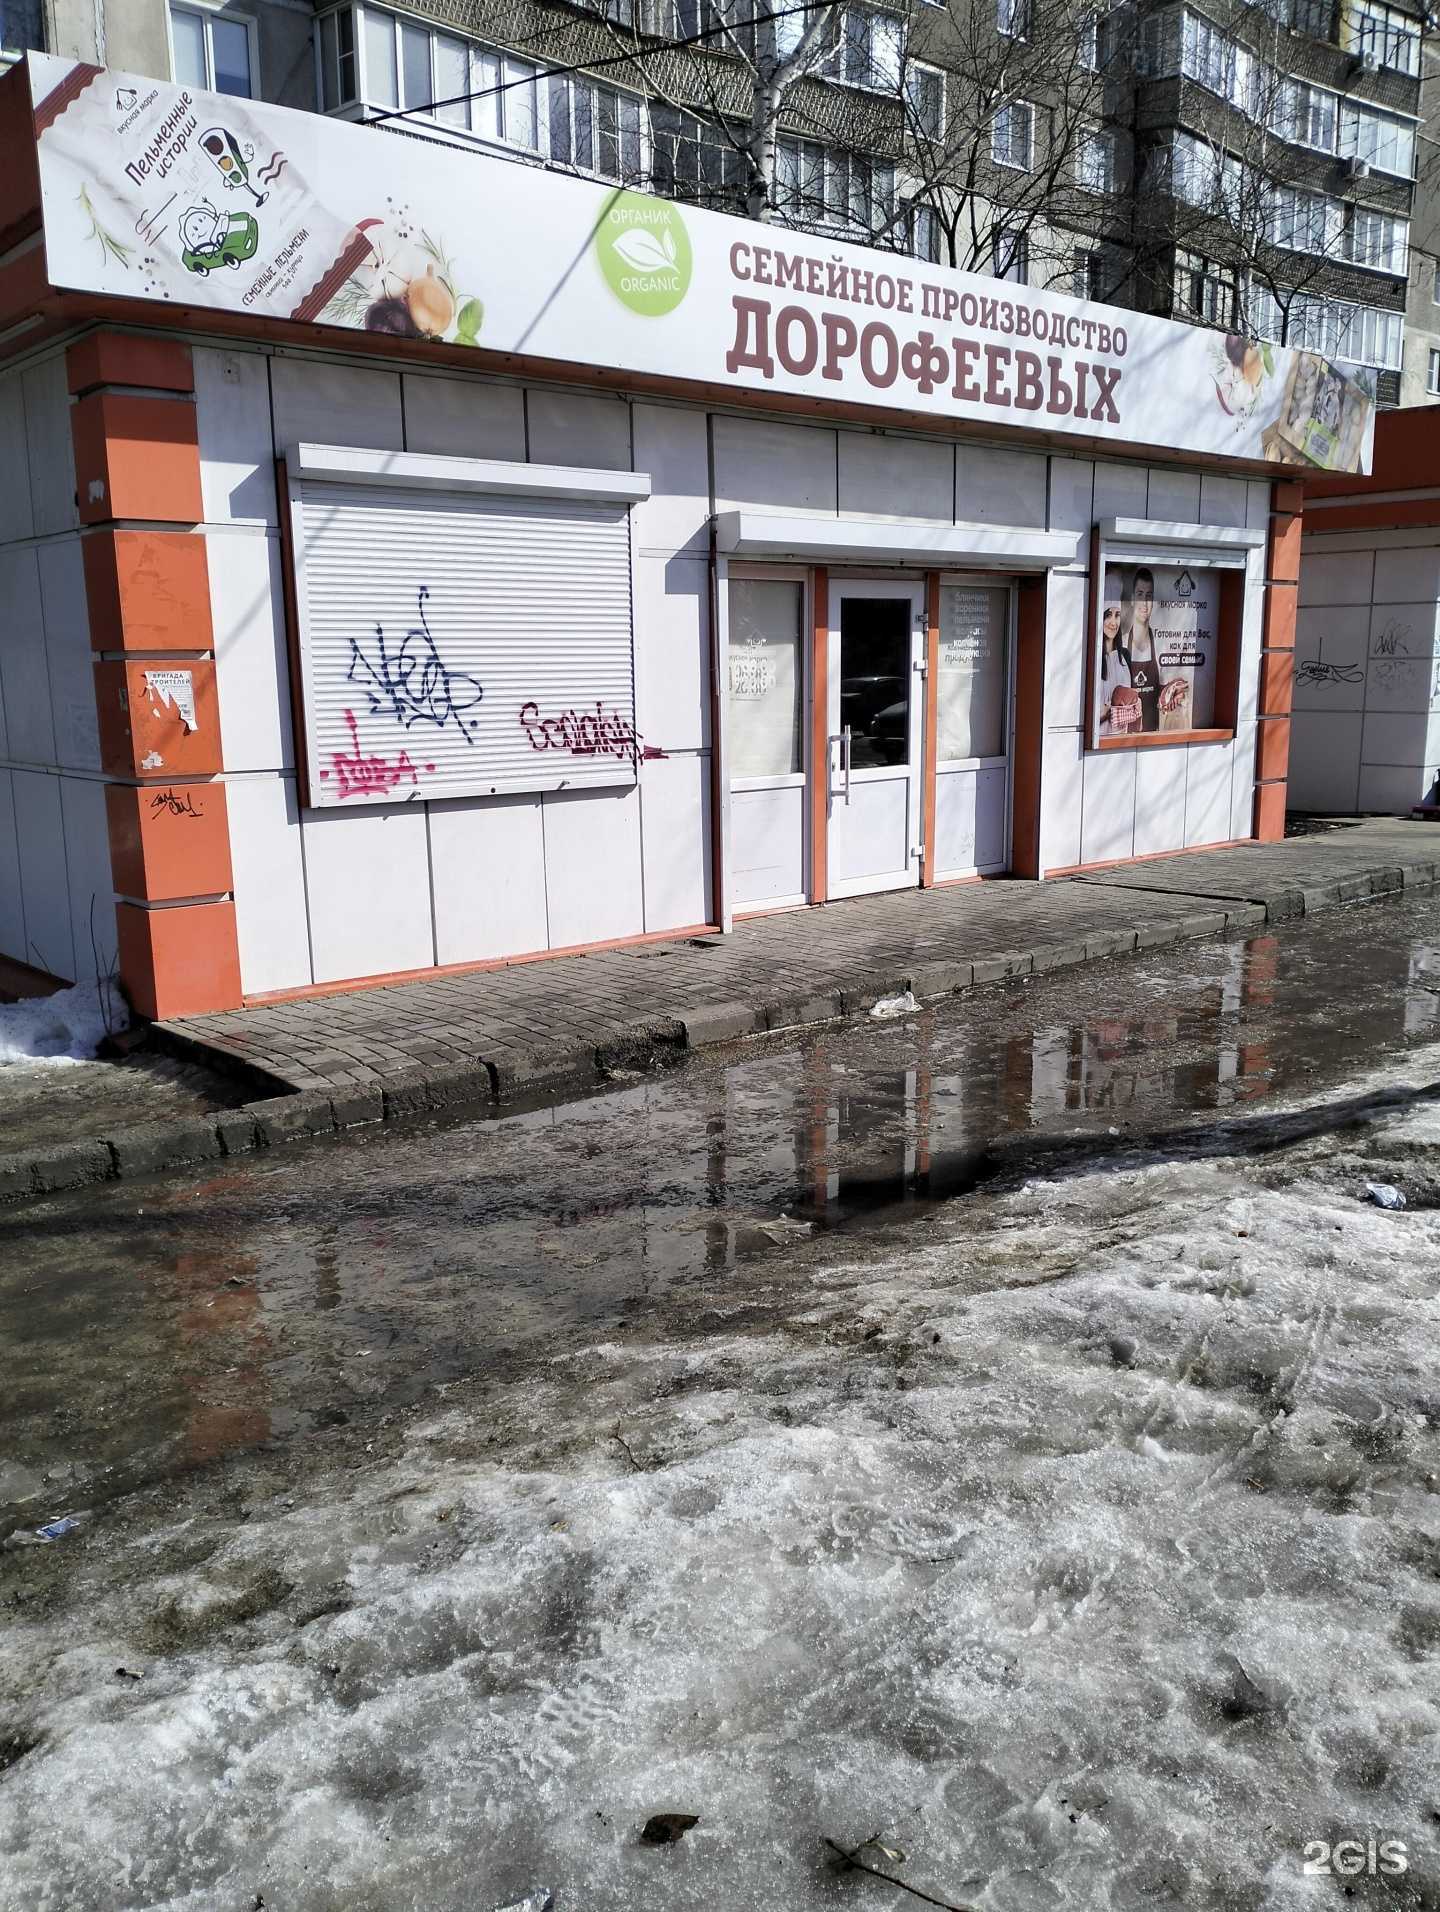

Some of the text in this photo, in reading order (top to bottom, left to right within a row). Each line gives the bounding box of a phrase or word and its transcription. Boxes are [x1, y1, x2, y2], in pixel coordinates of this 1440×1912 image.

[117, 89, 159, 135] вкусная марка
[124, 91, 194, 187] Пельменные
[156, 115, 198, 179] истории
[608, 208, 672, 225] ОРГАНИК
[241, 265, 277, 306] СЕМЕЙНЫЕ
[274, 228, 311, 269] ПЕЛЬМЕНИ
[620, 276, 681, 293] ORGANIC
[729, 241, 1128, 358] СЕМЕЙНОЕ ПРОИЗВОДСТВО
[725, 294, 1122, 425] ДОРОФЕЕВЫХ
[1160, 600, 1208, 611] вкусная марка
[1154, 628, 1182, 638] Готовим
[1183, 630, 1197, 639] для
[1169, 642, 1196, 651] как для
[1160, 653, 1181, 665] своей
